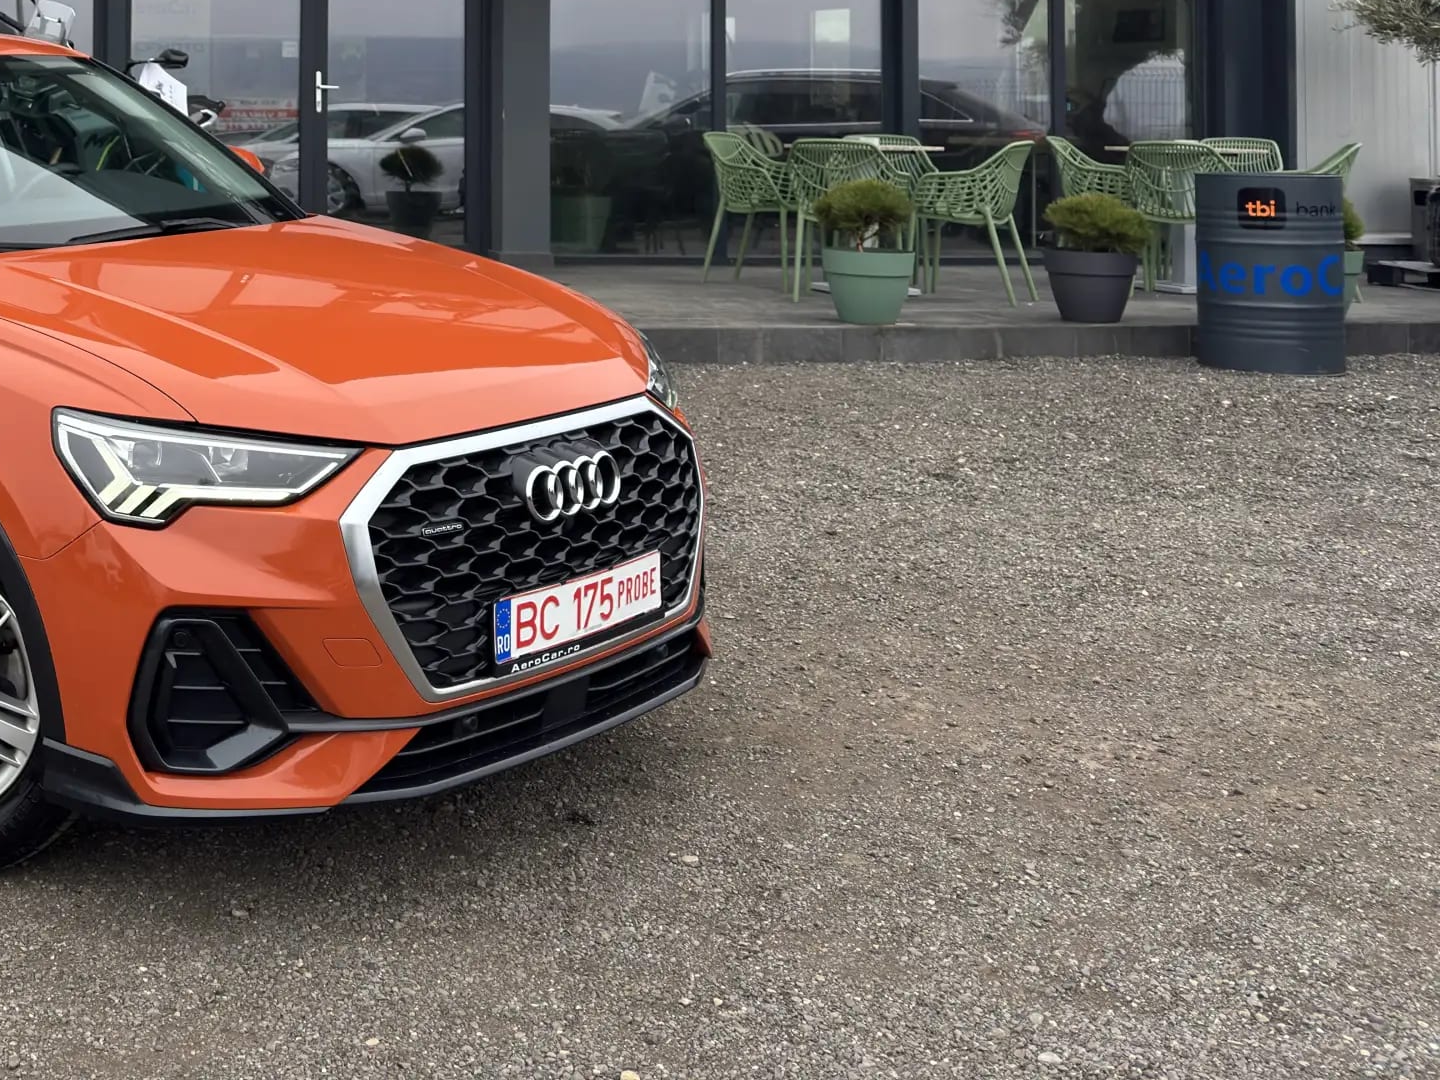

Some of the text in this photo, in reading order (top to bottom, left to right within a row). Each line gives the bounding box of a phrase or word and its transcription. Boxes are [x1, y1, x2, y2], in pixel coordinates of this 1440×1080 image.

[1245, 199, 1336, 217] tbi bank
[497, 566, 657, 655] RO BC 175 PROBE
[511, 643, 581, 673] AeroCar.ro
